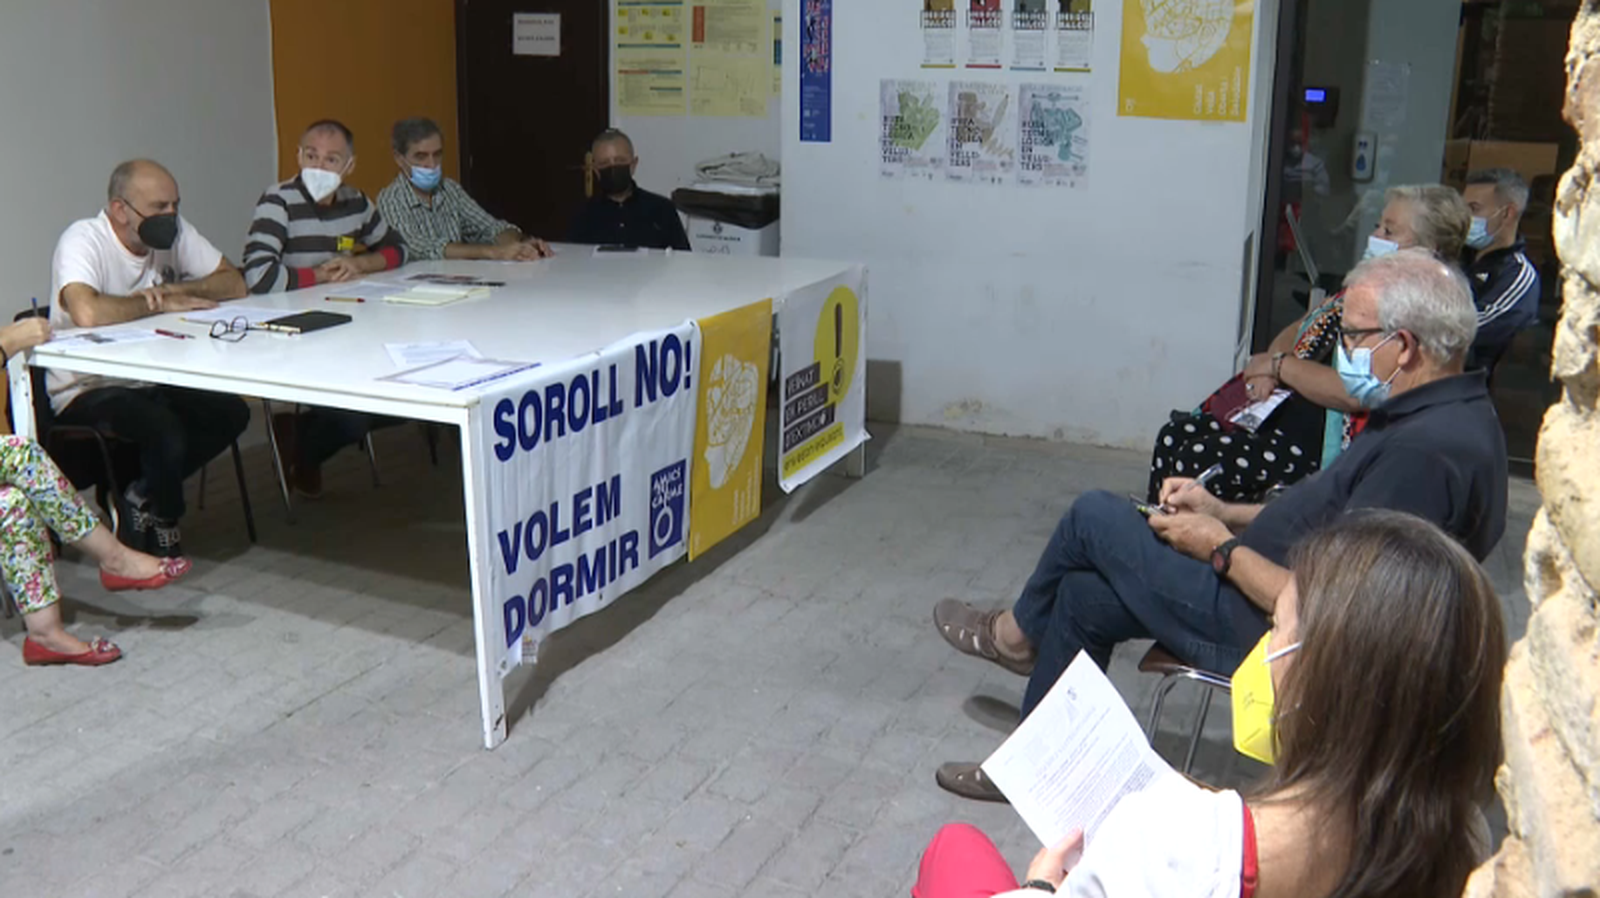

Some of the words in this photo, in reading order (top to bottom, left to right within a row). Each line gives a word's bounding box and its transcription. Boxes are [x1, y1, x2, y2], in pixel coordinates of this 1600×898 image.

[493, 363, 624, 462] SOROLL
[634, 333, 691, 408] NO!
[497, 473, 621, 576] VOLEM
[503, 529, 640, 649] DORMIR
